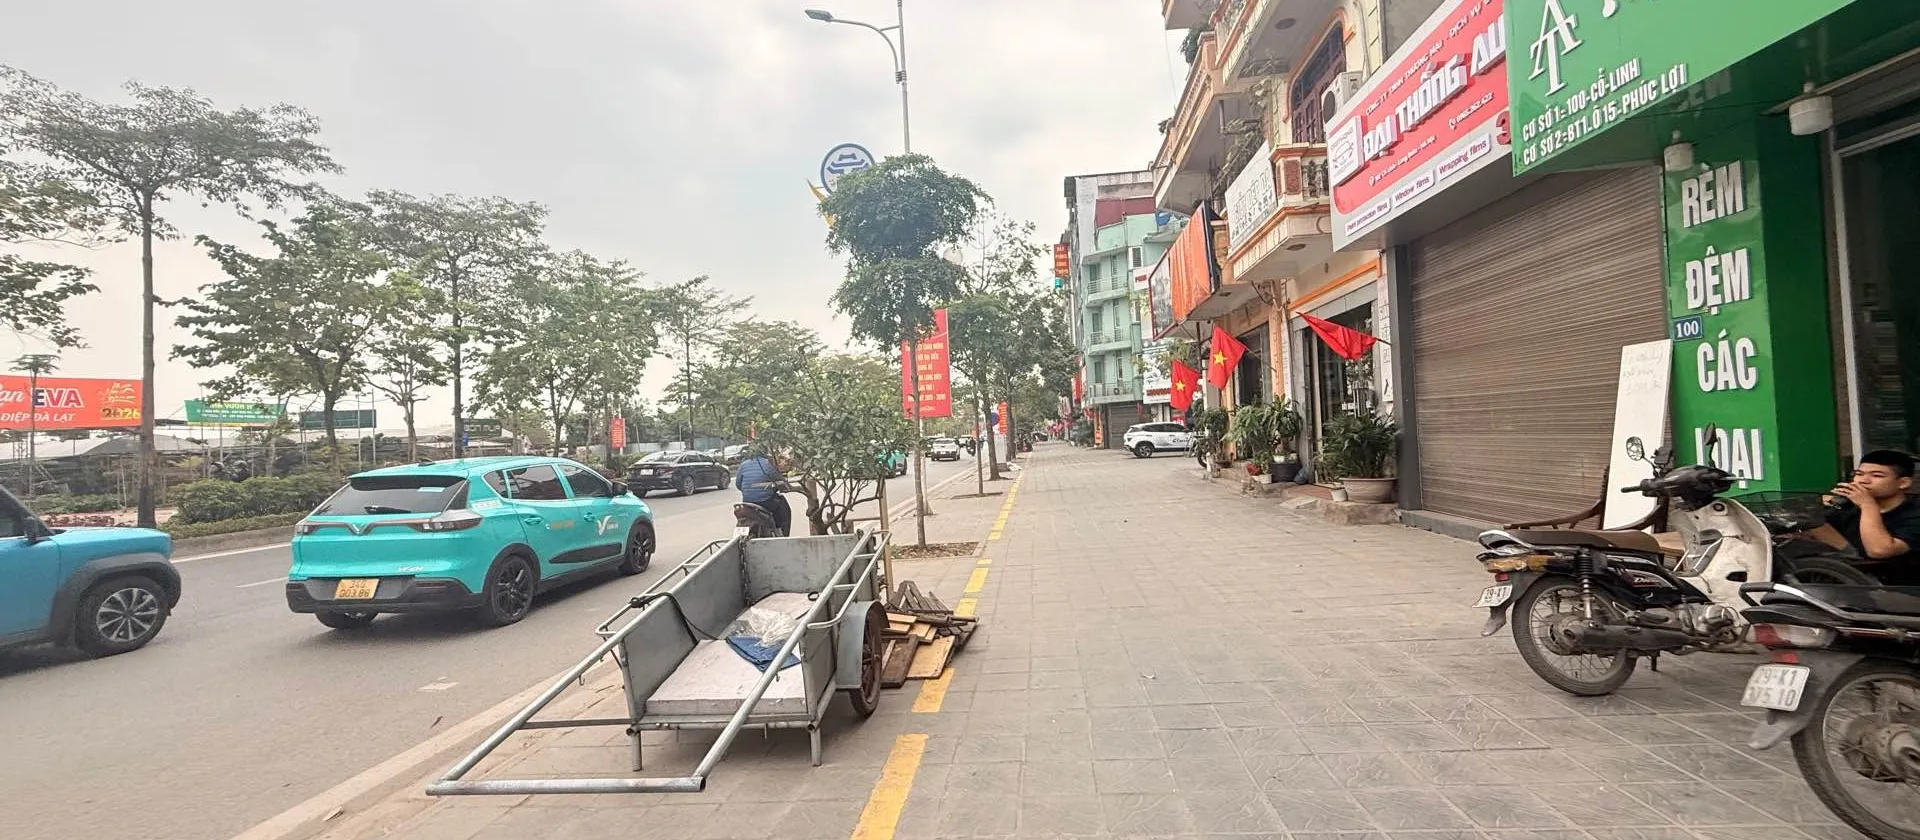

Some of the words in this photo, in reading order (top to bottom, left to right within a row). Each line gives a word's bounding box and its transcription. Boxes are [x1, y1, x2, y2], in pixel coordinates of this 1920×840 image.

[1363, 115, 1397, 163] ĐẠI
[1395, 53, 1468, 133] THỐNG
[1522, 120, 1537, 142] CƠ
[1538, 104, 1554, 134] SỞ
[1523, 145, 1537, 165] CƠ
[1540, 130, 1554, 157] SỞ
[1660, 62, 1688, 95] LỢI
[1439, 149, 1469, 174] Wrapping
[1470, 140, 1487, 155] films
[1395, 186, 1415, 202] Window
[1416, 176, 1430, 188] films
[1681, 160, 1744, 228] RÈM
[1685, 245, 1750, 315] ĐỆM
[1676, 320, 1699, 338] 100
[1697, 328, 1757, 393] CÁC
[32, 387, 84, 408] EVA
[53, 412, 77, 423] LẠT
